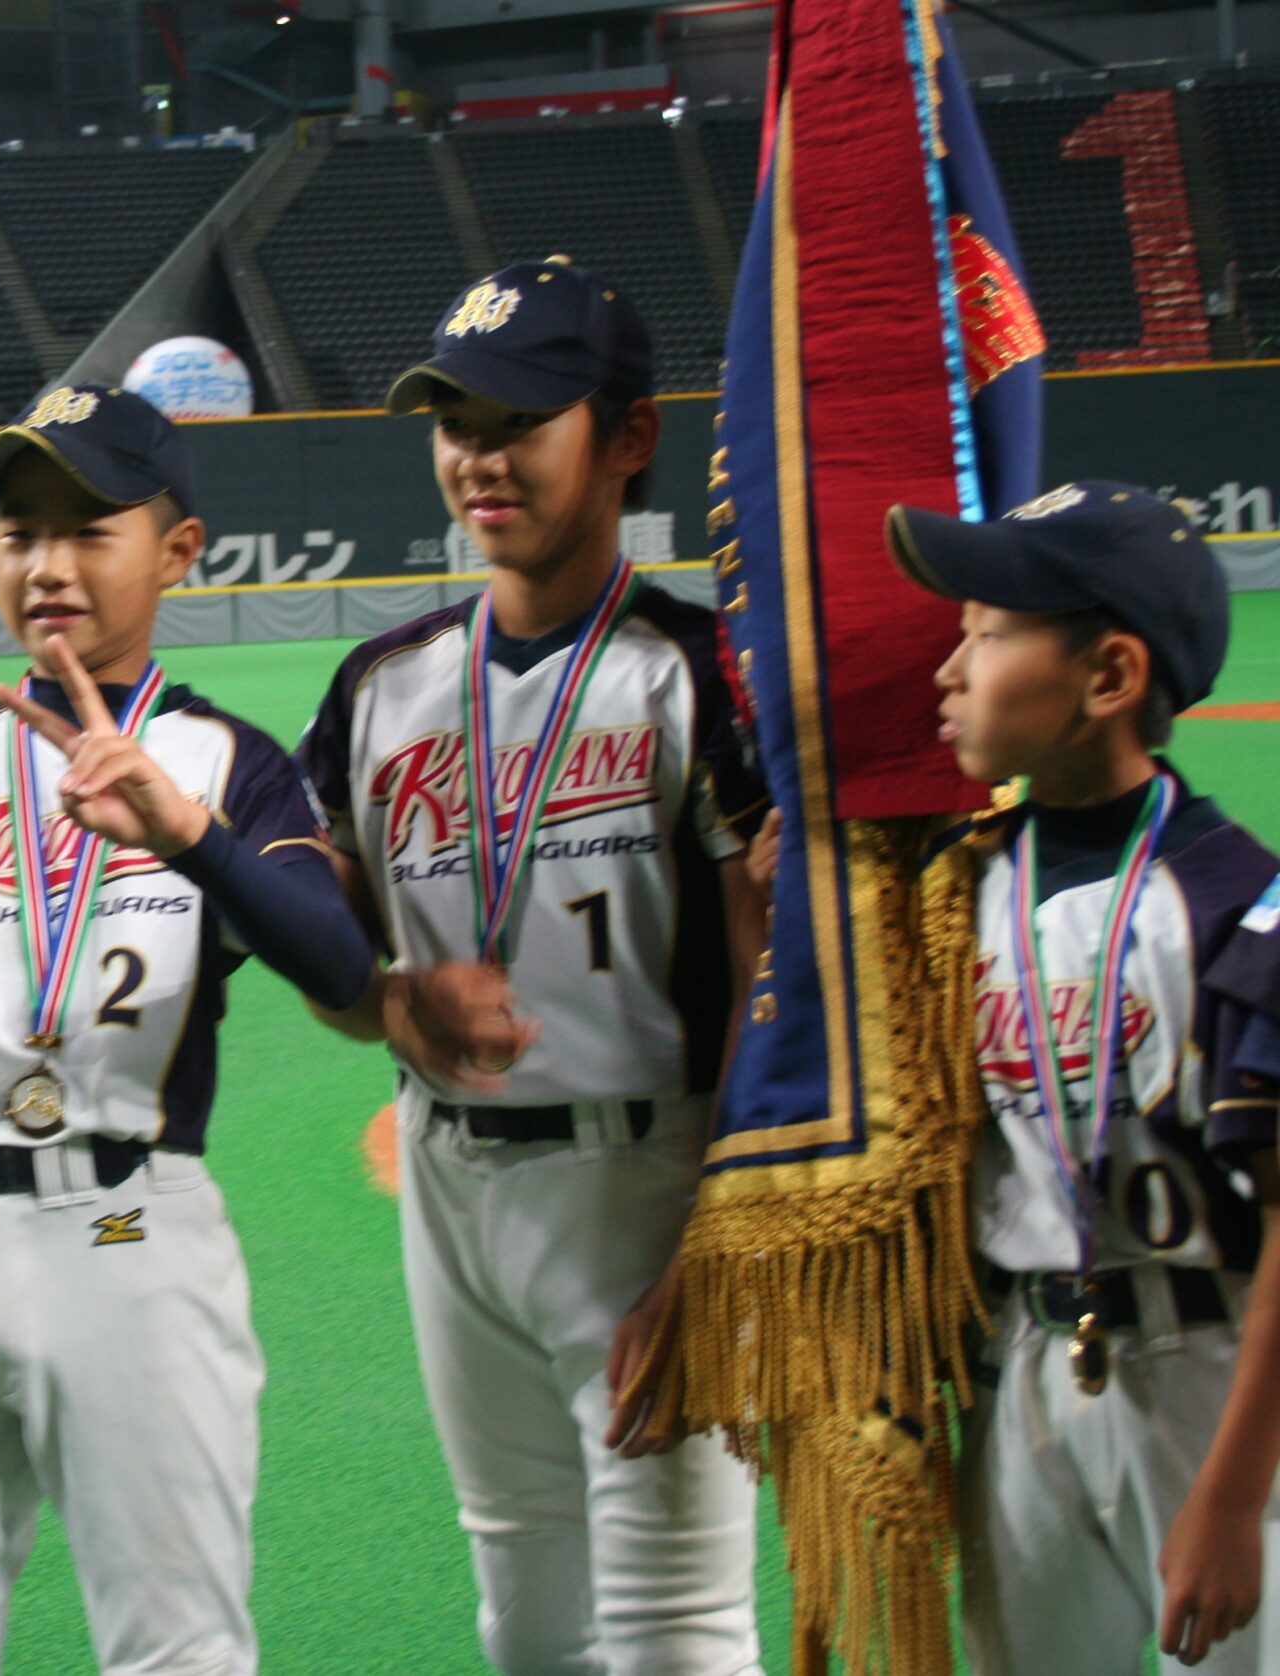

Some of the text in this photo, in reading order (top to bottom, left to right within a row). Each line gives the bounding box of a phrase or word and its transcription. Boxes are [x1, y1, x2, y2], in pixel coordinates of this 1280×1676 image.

[528, 834, 661, 863] GUARS
[562, 889, 613, 972] 1
[97, 947, 144, 1028] 2
